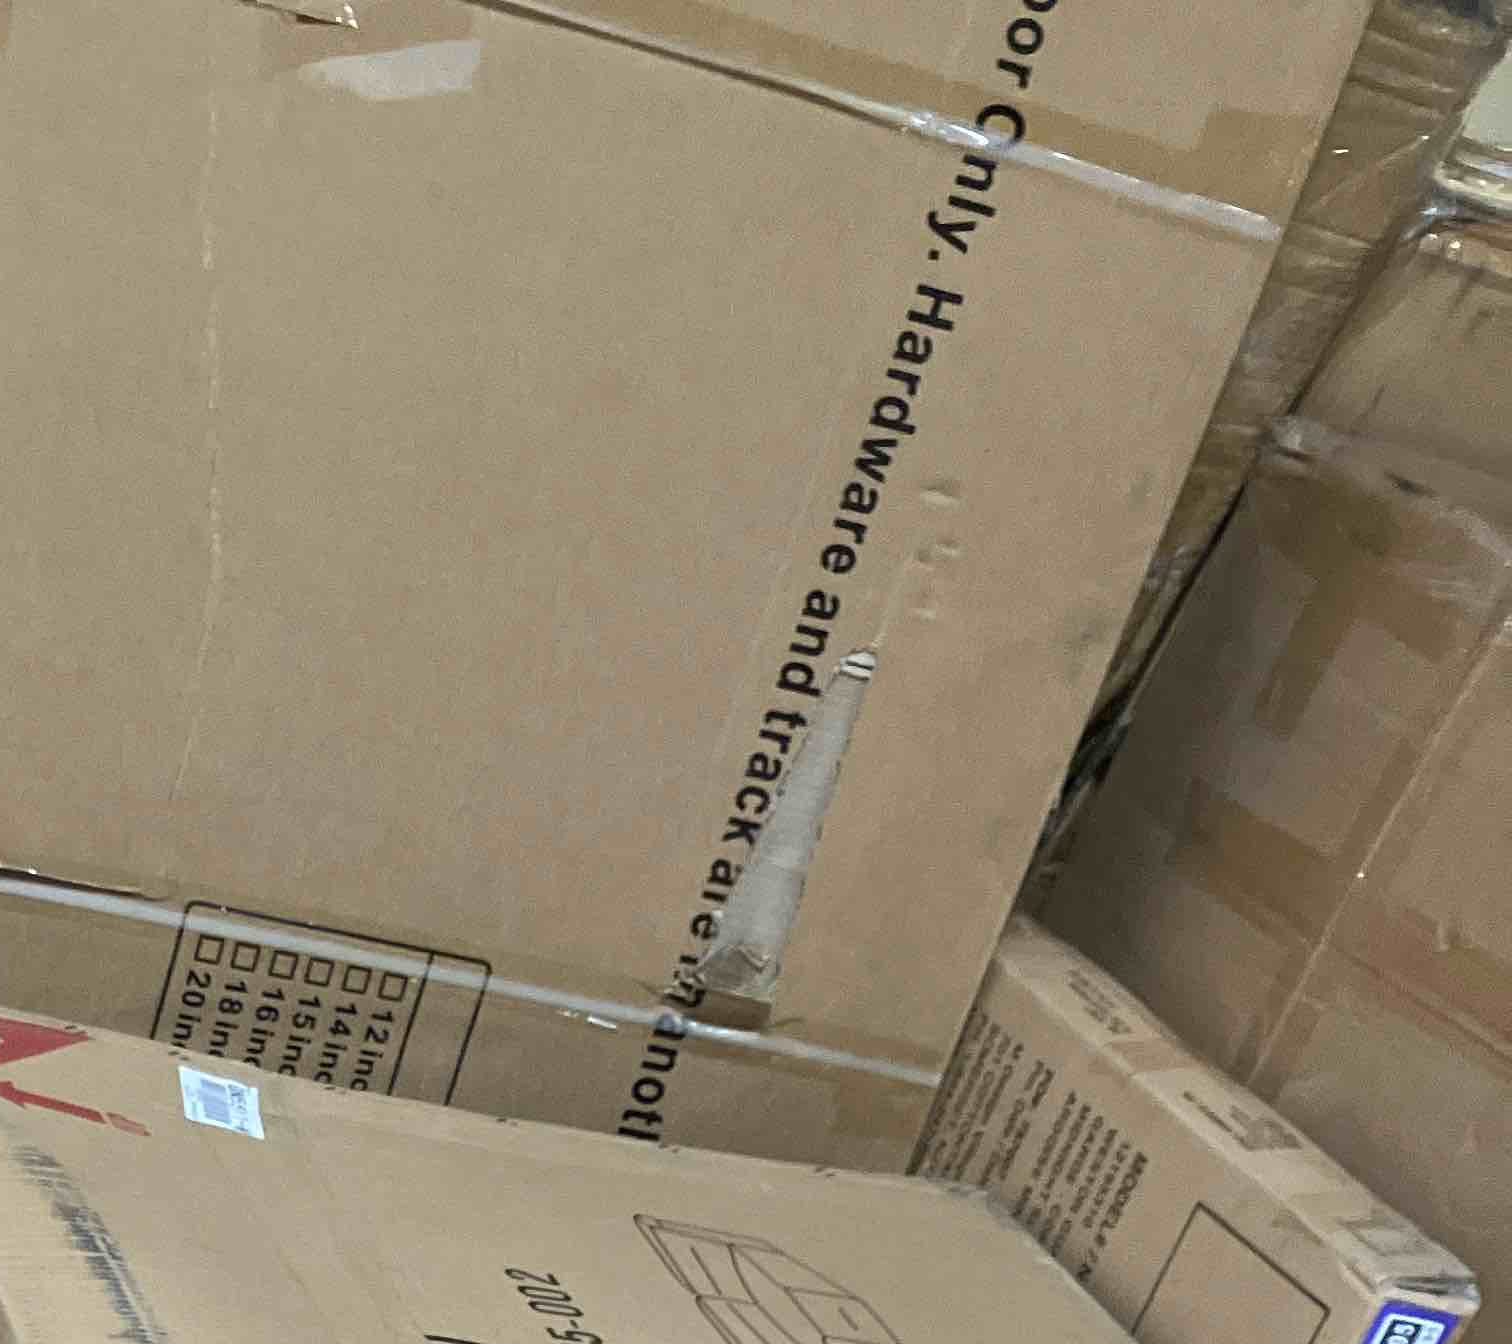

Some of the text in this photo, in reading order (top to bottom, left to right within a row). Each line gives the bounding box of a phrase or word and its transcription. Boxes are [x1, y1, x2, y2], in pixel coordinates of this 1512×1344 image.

[996, 0, 1058, 89] or
[820, 284, 964, 575] Hardware
[775, 588, 840, 698] and
[722, 708, 808, 846] track
[180, 969, 212, 1009] 20
[218, 980, 249, 1016] 18
[255, 986, 285, 1024] 16
[291, 995, 322, 1031] 15
[313, 1002, 358, 1084] 14 inc
[350, 1009, 396, 1091] 12 inc
